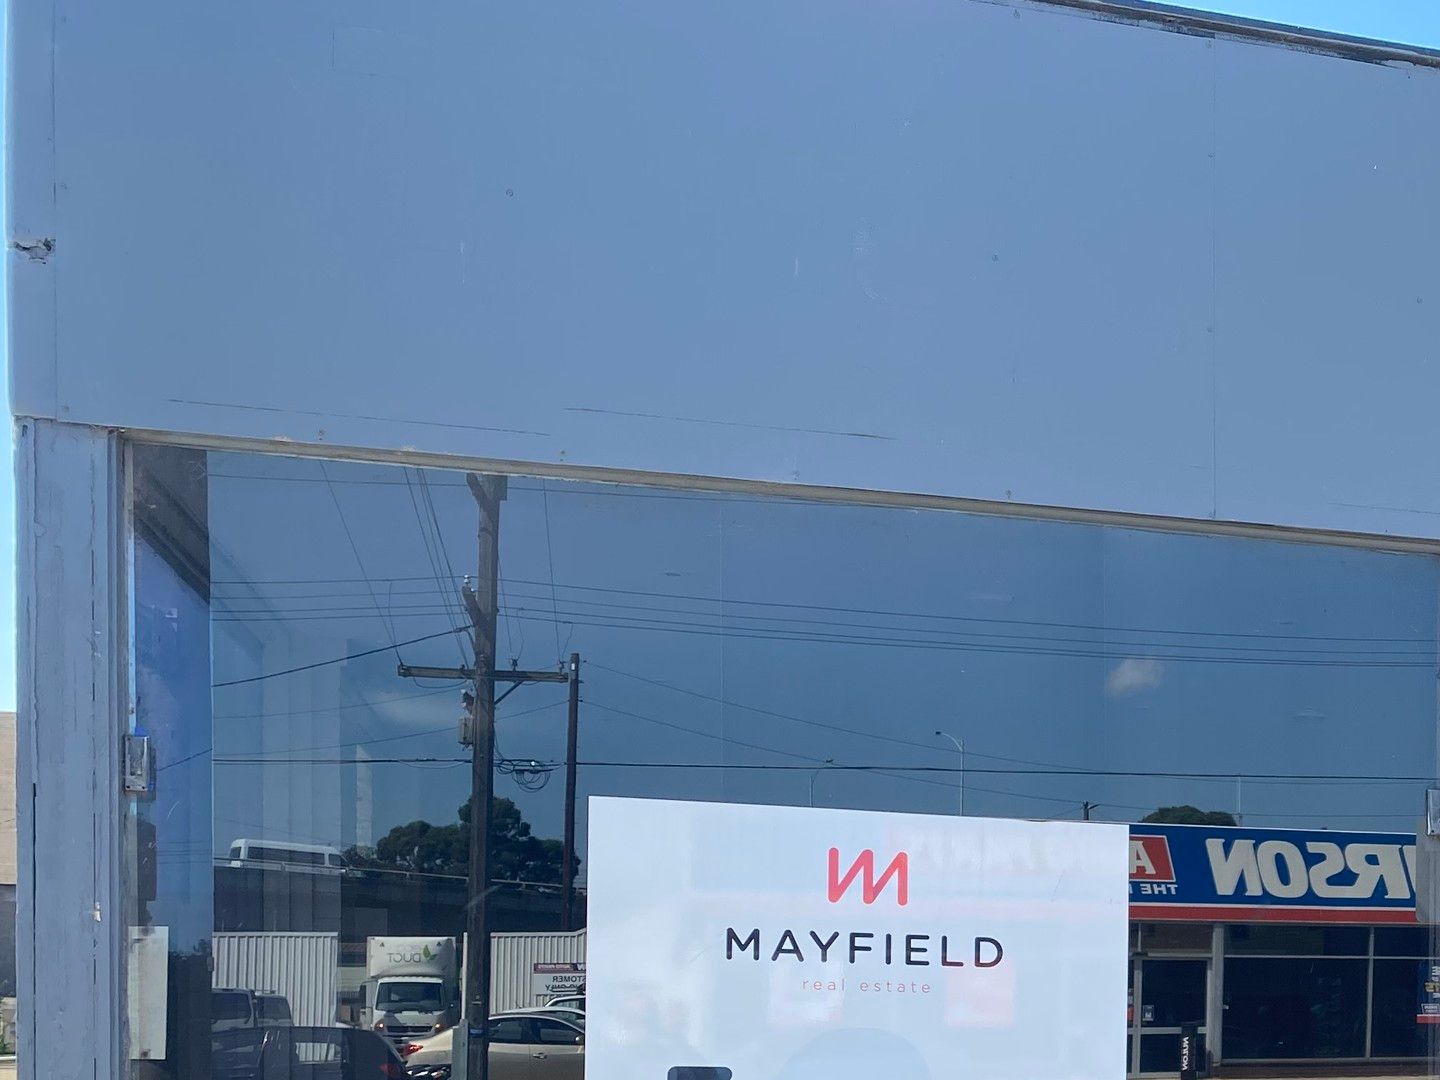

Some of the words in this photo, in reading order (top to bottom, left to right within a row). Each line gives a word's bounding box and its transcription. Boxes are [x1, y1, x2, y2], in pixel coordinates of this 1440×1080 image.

[726, 927, 1004, 969] MAYFIELD
[802, 978, 846, 993] real
[859, 979, 932, 994] estate
